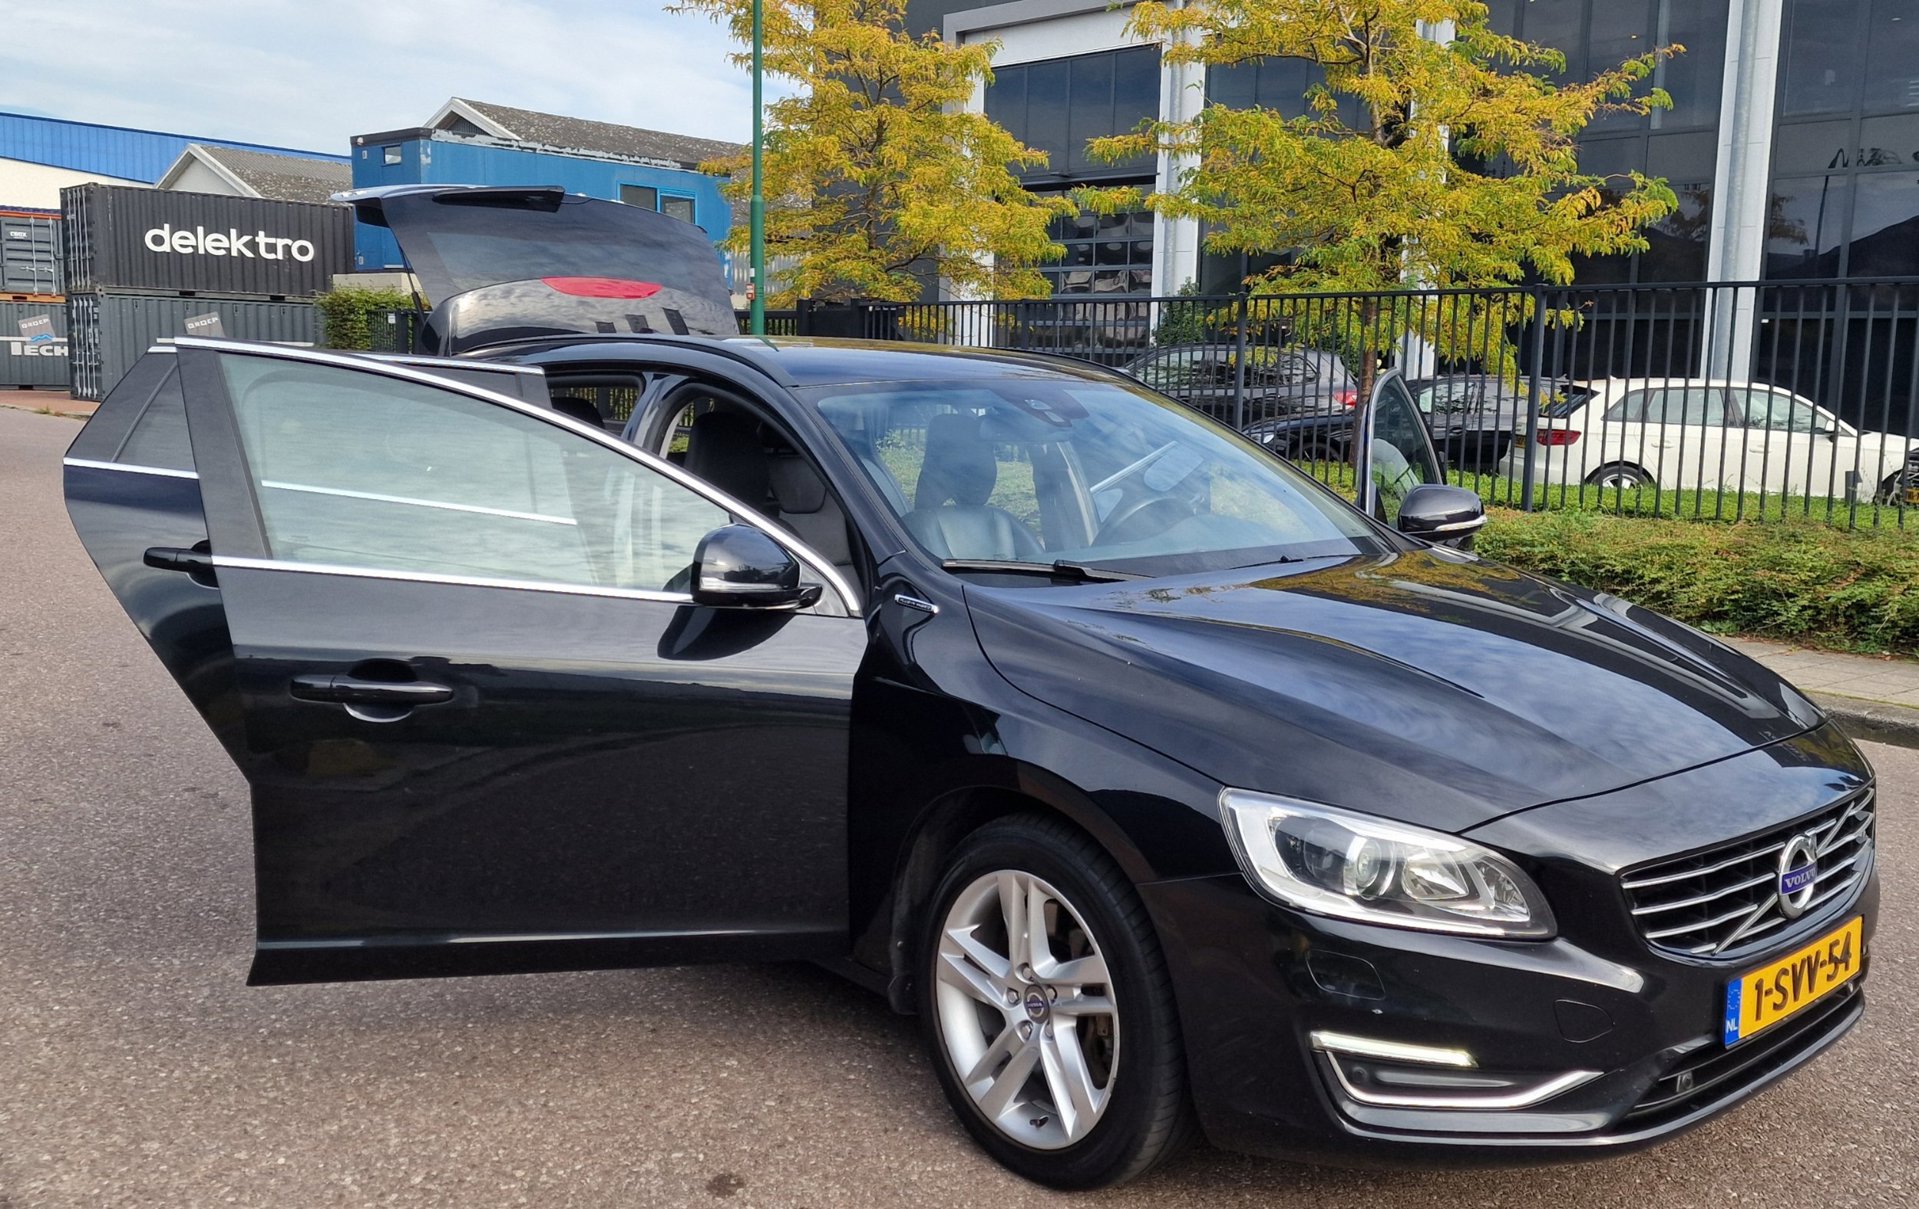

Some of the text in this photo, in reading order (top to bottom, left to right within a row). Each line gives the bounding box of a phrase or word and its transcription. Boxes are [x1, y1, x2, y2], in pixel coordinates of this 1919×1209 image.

[145, 224, 314, 262] delektro
[1784, 866, 1817, 888] VOLVO
[1755, 931, 1852, 1022] 1-SVV-54
[1726, 1018, 1738, 1034] NL
